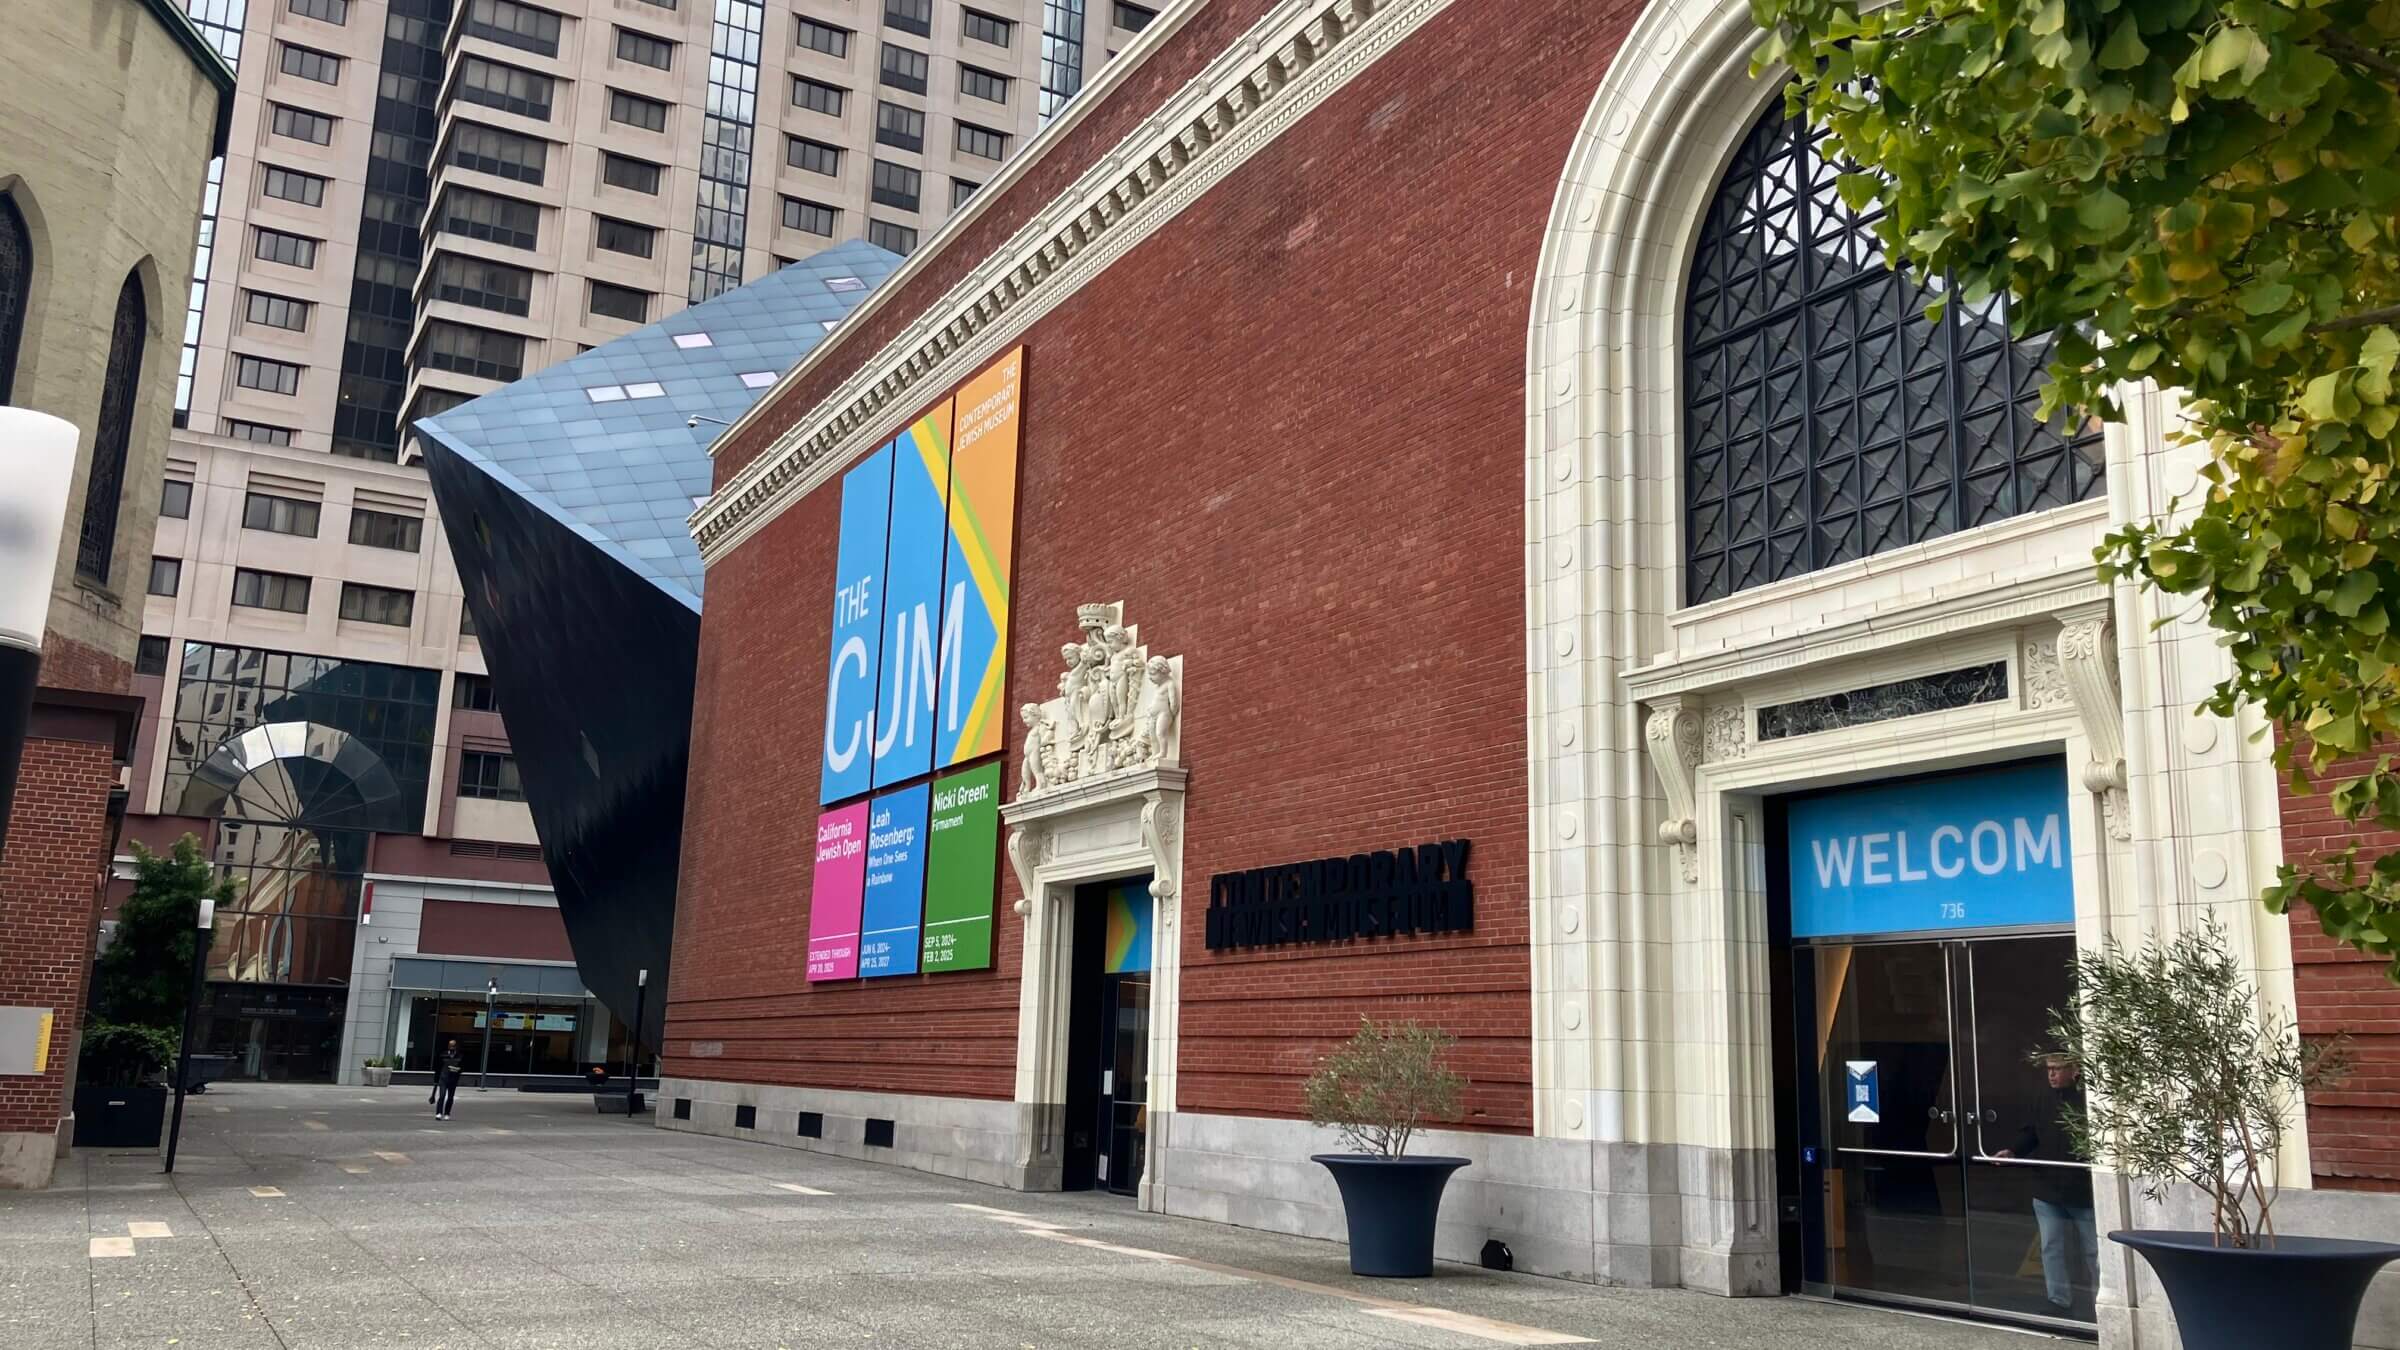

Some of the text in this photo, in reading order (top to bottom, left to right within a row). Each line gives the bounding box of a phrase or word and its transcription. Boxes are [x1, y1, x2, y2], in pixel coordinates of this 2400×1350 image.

[1002, 361, 1017, 384] THE
[960, 382, 1015, 432] CONTEMPORARY
[957, 400, 1015, 453] JEWISH MUSEUM
[839, 575, 872, 628] THE
[826, 580, 966, 773] CJM
[933, 783, 989, 813] Nicki Green:
[871, 808, 890, 829] Leah
[931, 814, 963, 833] Firmament
[818, 819, 852, 843] California
[870, 826, 915, 851] Rosenberg:
[816, 839, 862, 863] Jewish Open
[868, 850, 908, 868] When One Sees
[871, 872, 893, 886] Rainbow
[1939, 902, 1965, 919] 736
[924, 936, 935, 949] SEP
[923, 951, 934, 963] FEB
